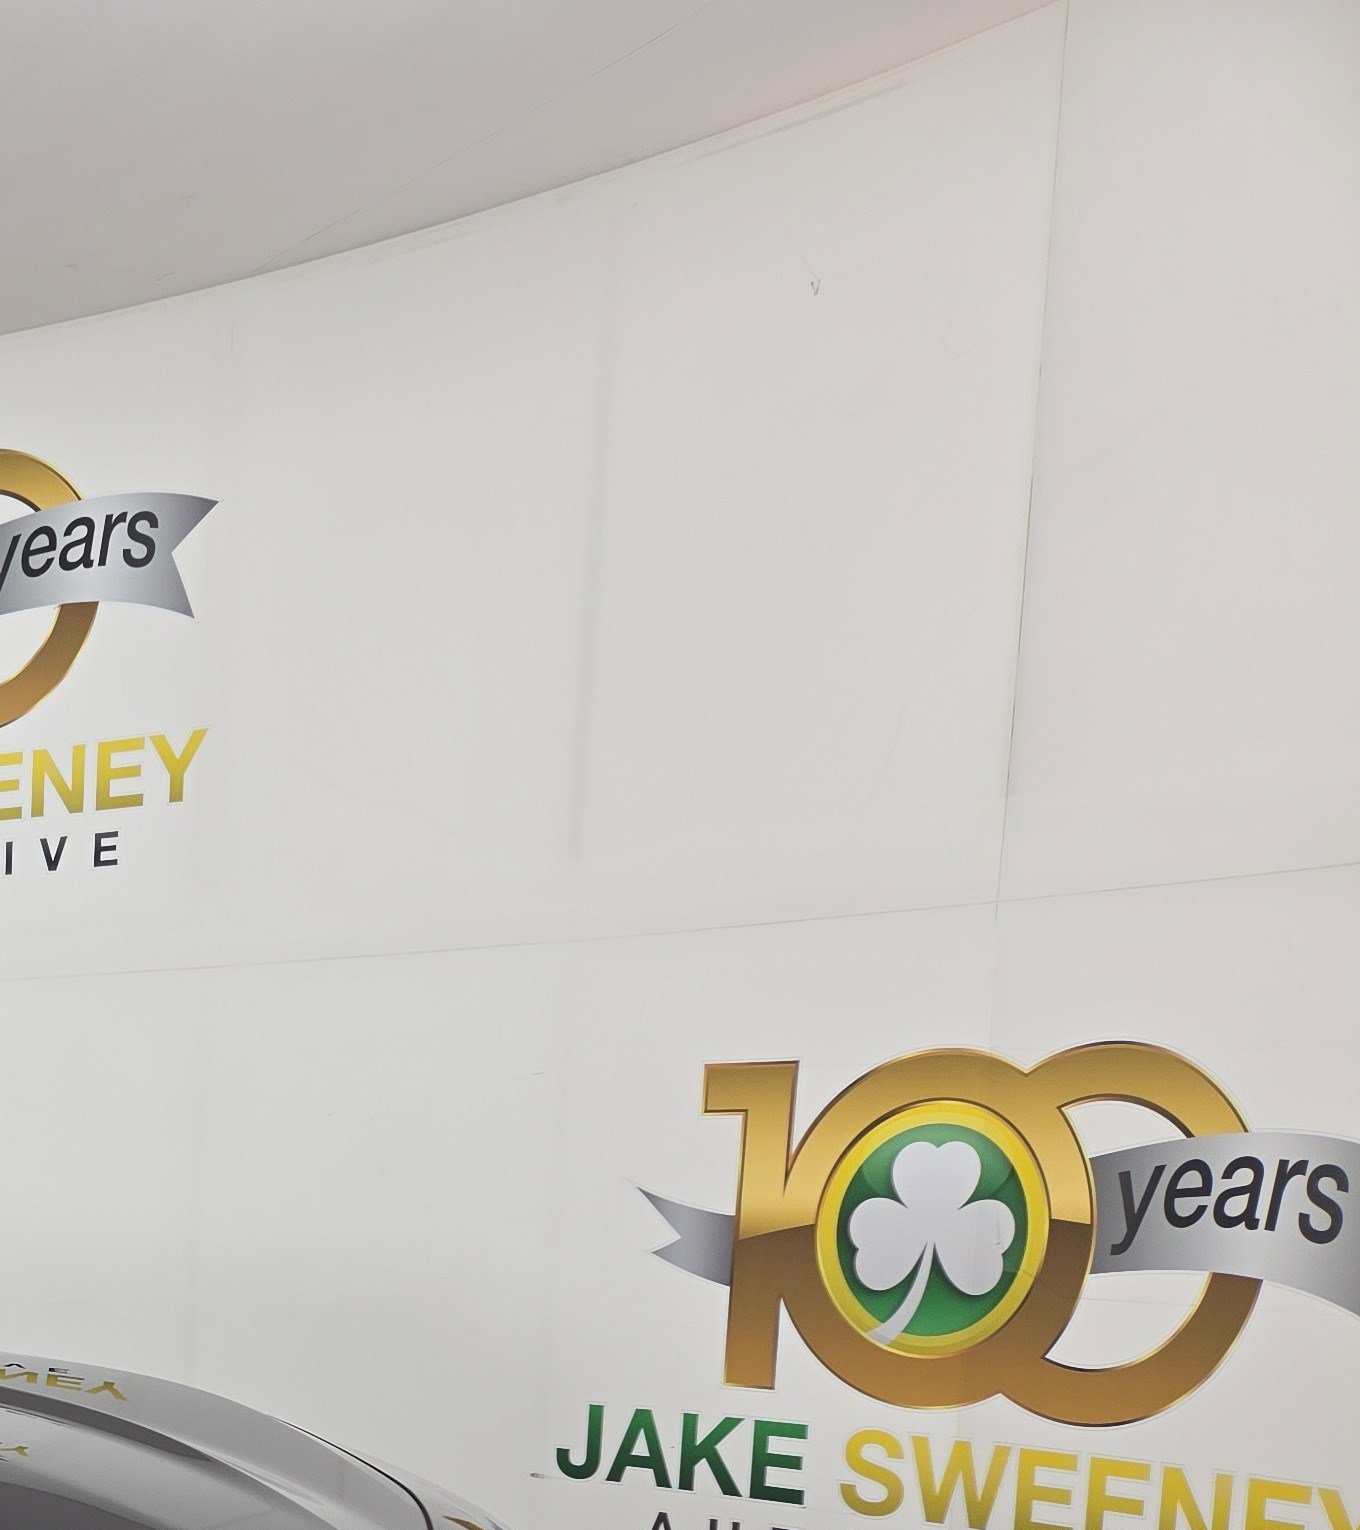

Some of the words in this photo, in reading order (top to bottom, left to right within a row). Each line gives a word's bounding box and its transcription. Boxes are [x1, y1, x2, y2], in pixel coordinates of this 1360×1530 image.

[703, 1041, 1262, 1426] 100
[1111, 1155, 1348, 1255] years
[556, 1403, 809, 1506] JAKE
